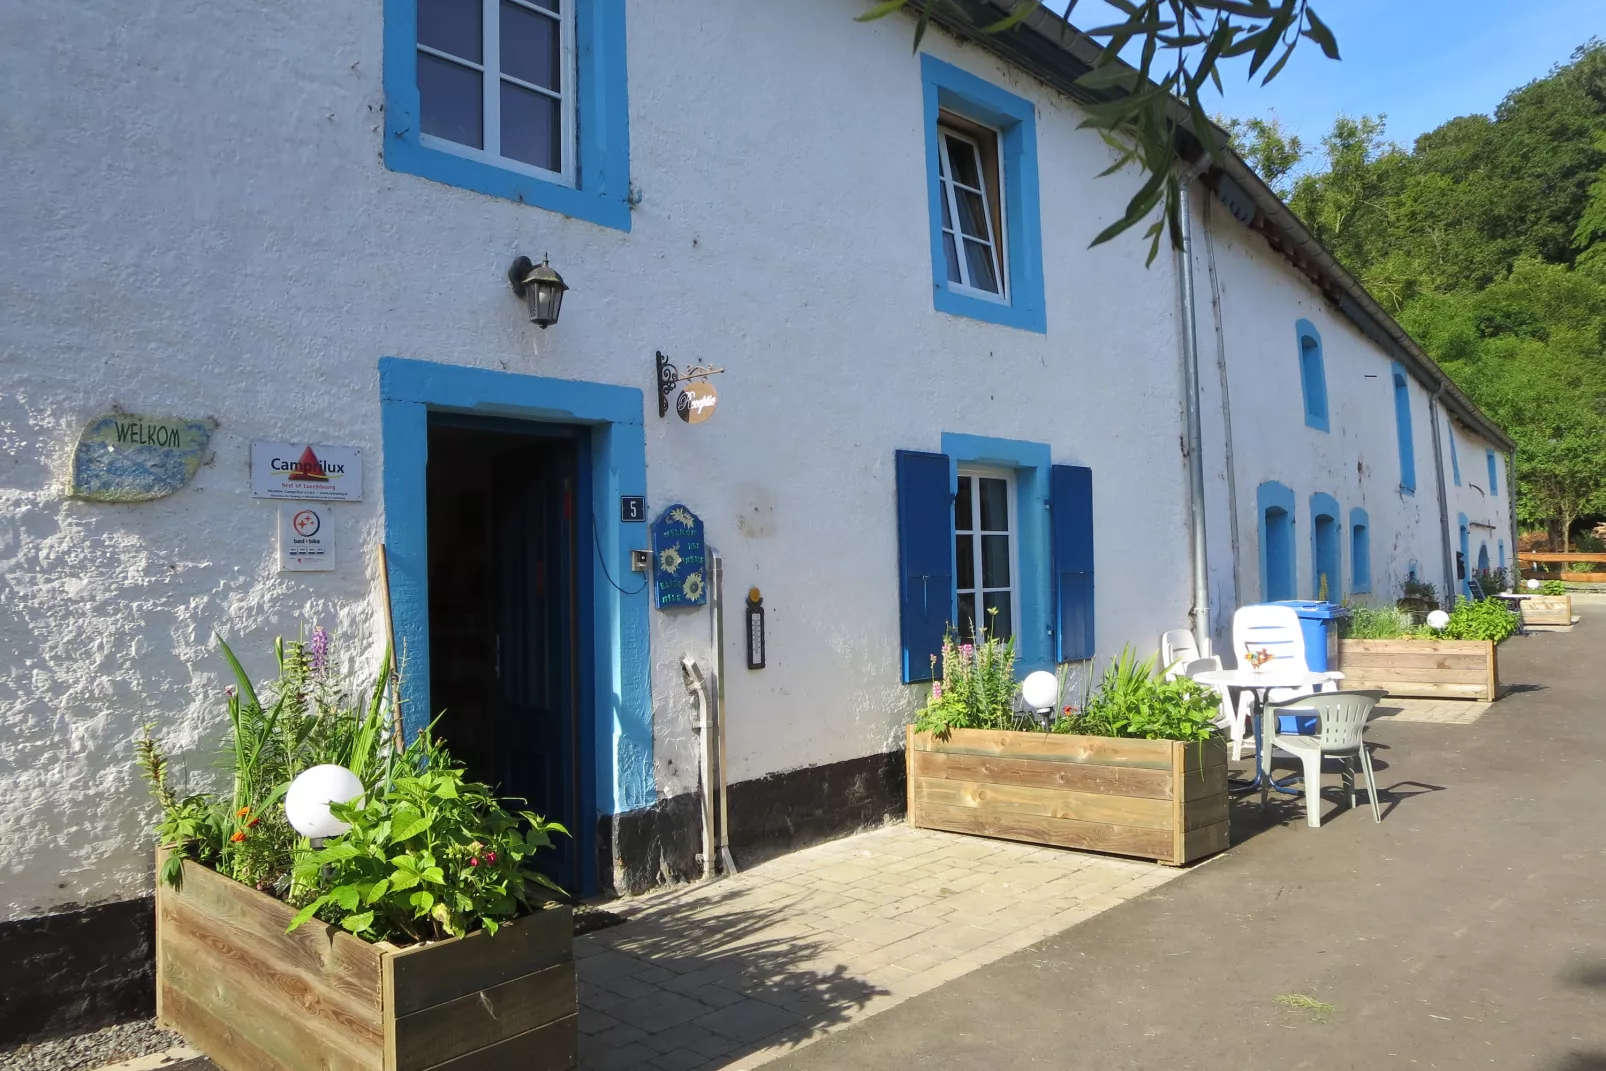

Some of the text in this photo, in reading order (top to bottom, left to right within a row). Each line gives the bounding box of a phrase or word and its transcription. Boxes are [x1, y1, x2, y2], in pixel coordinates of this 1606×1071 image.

[114, 421, 181, 449] WELKOM
[271, 458, 345, 474] Camprilux
[303, 483, 336, 491] Luxembourg
[630, 501, 637, 517] 5
